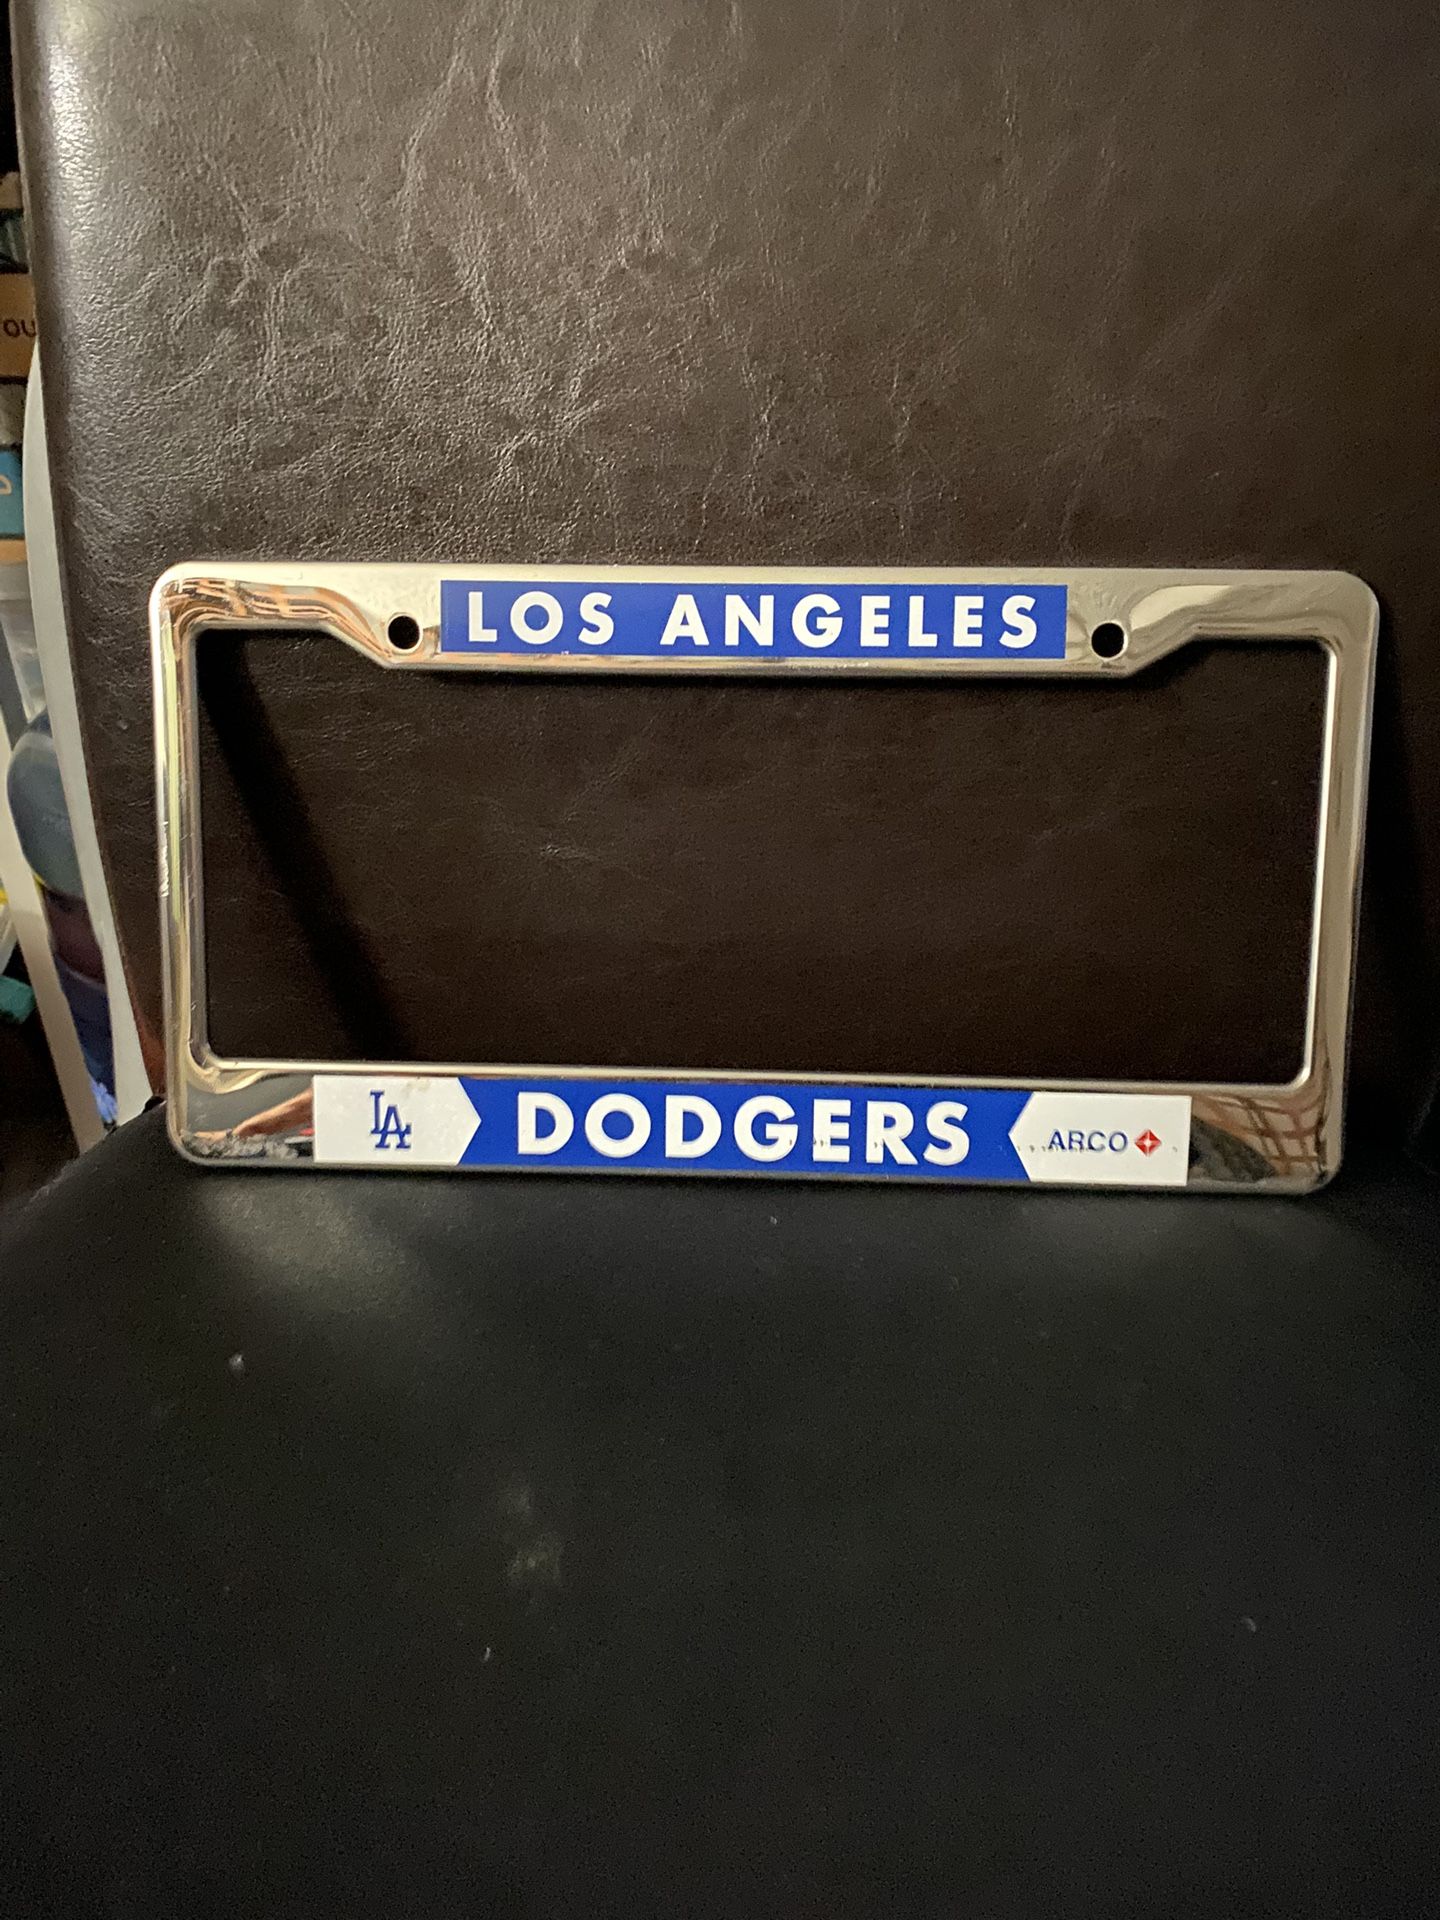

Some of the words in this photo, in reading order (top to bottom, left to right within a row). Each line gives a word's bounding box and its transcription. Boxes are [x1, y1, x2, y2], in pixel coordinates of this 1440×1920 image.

[467, 590, 615, 646] LOS
[659, 593, 1038, 649] ANGELES
[370, 1090, 412, 1149] LA
[517, 1091, 970, 1166] DODGERS
[1048, 1130, 1128, 1152] ARCO
